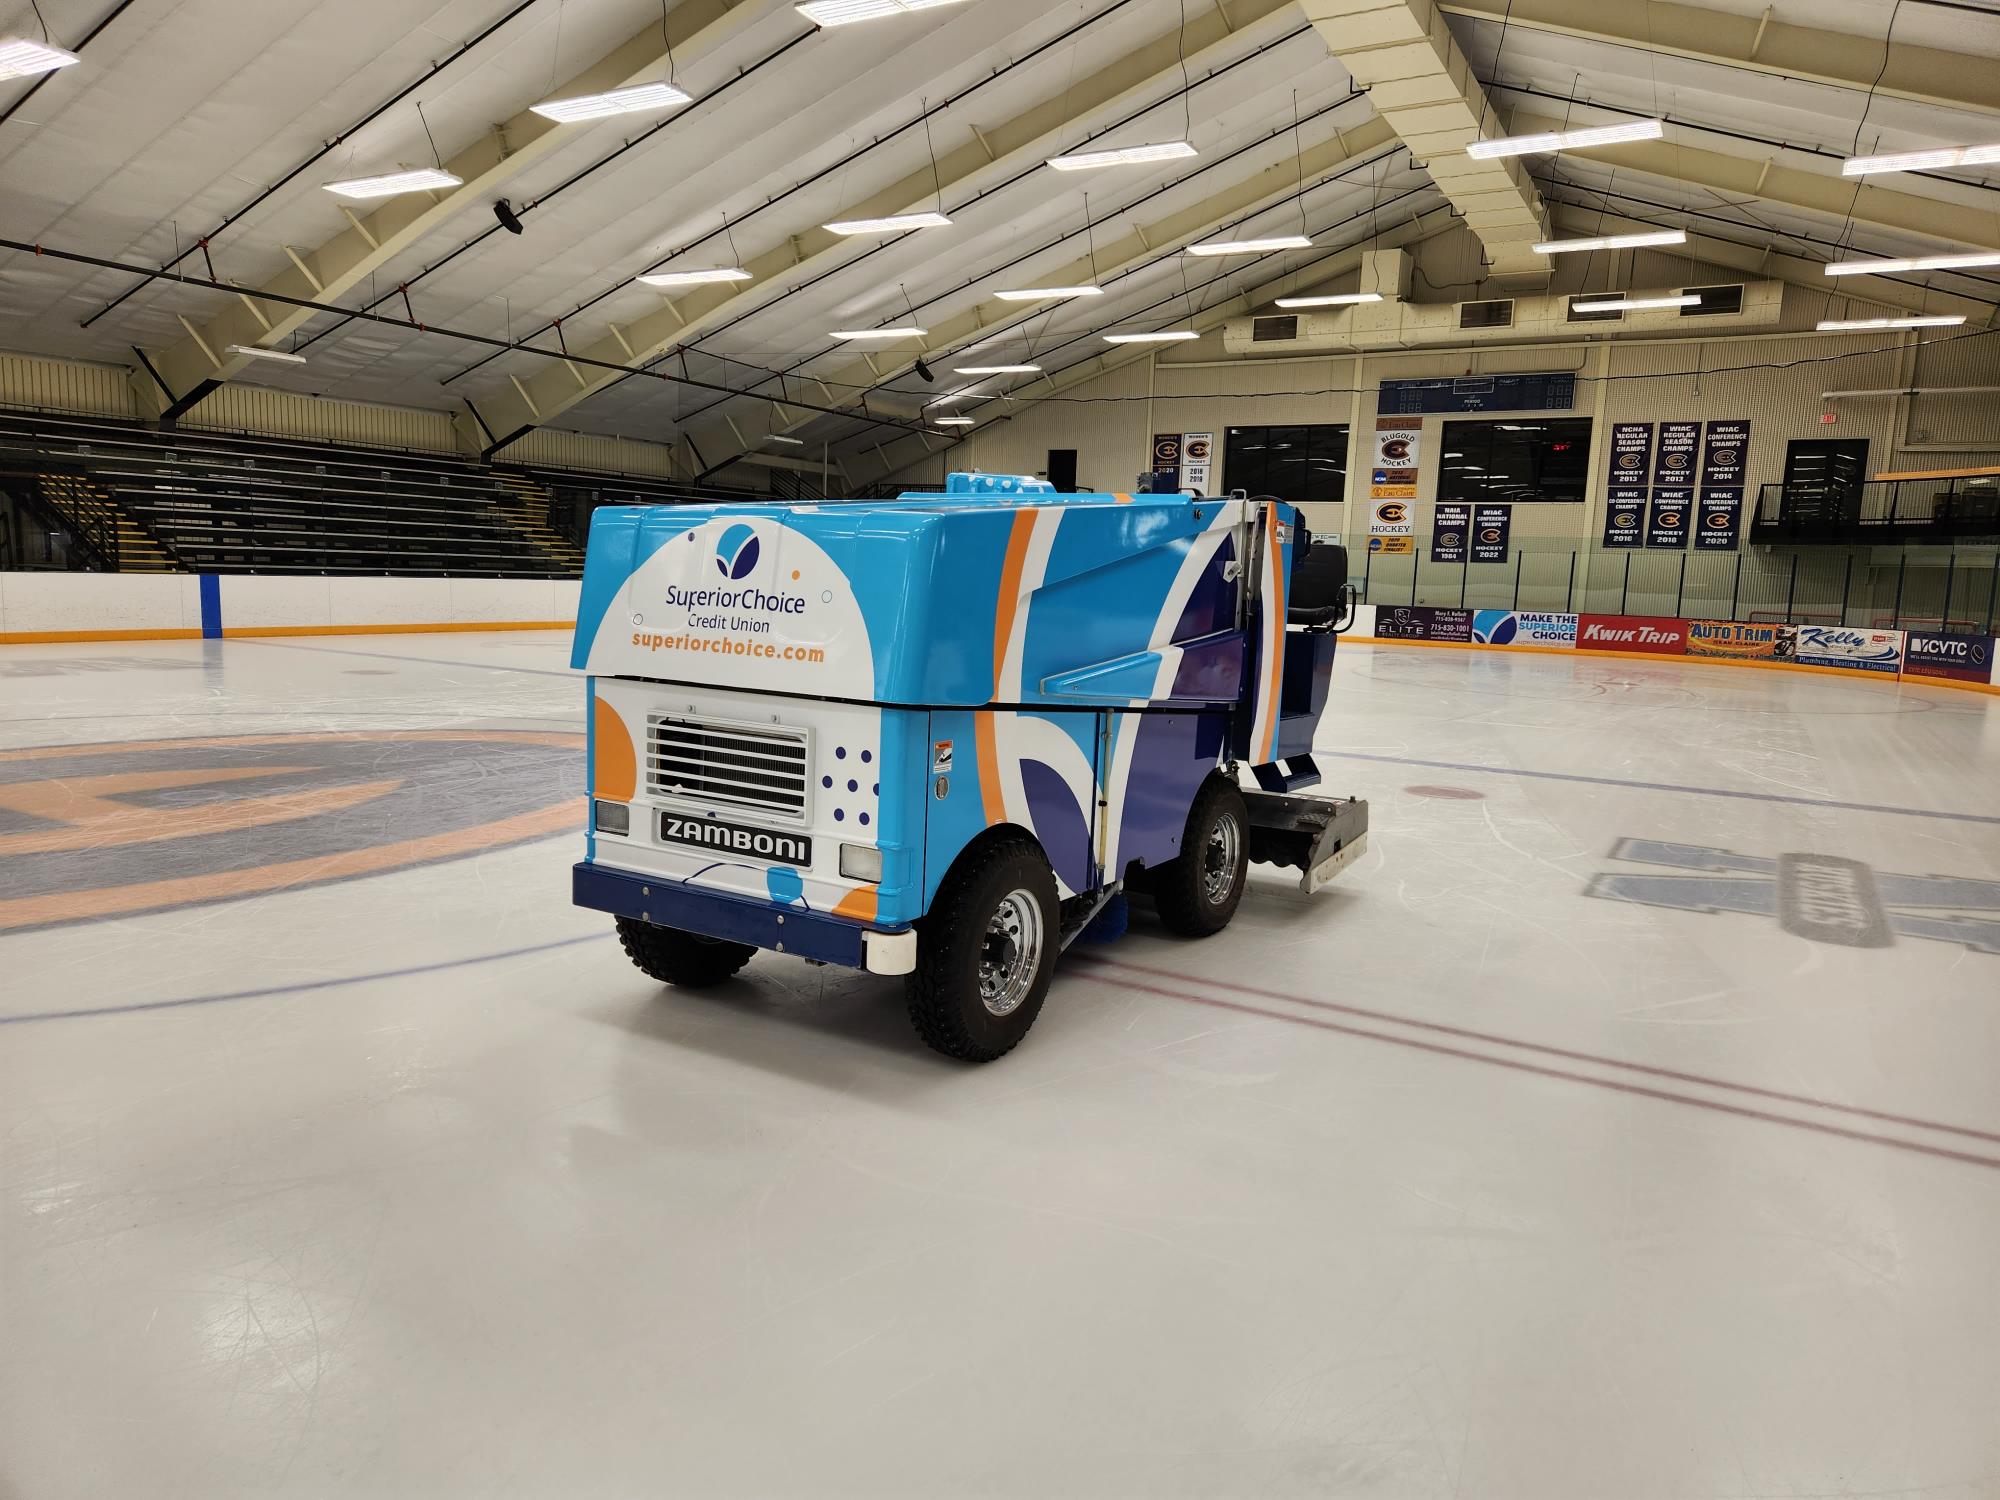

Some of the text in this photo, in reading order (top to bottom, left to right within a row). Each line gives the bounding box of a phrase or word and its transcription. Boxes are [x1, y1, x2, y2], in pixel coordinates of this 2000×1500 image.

[1381, 432, 1415, 443] BLUGOLD
[1381, 457, 1411, 467] HOCKEY
[666, 585, 805, 613] SuperiorChoice
[688, 613, 770, 633] Credit Union
[1520, 614, 1578, 624] MAKE THE
[1379, 625, 1424, 635] ELITE
[1519, 622, 1576, 633] SUPERIOR
[1691, 624, 1773, 642] AUTO TRIM
[1516, 640, 1575, 648] superiorchoice.com
[1532, 631, 1576, 641] CHOICE
[1801, 628, 1866, 648] Kelly
[632, 633, 825, 663] superiorchoice.com
[1928, 640, 1967, 656] CVTC
[1800, 656, 1831, 666] Plumbing,
[1833, 660, 1857, 668] Heating
[1867, 662, 1896, 672] Electrical
[667, 818, 805, 860] ZAMBONI
